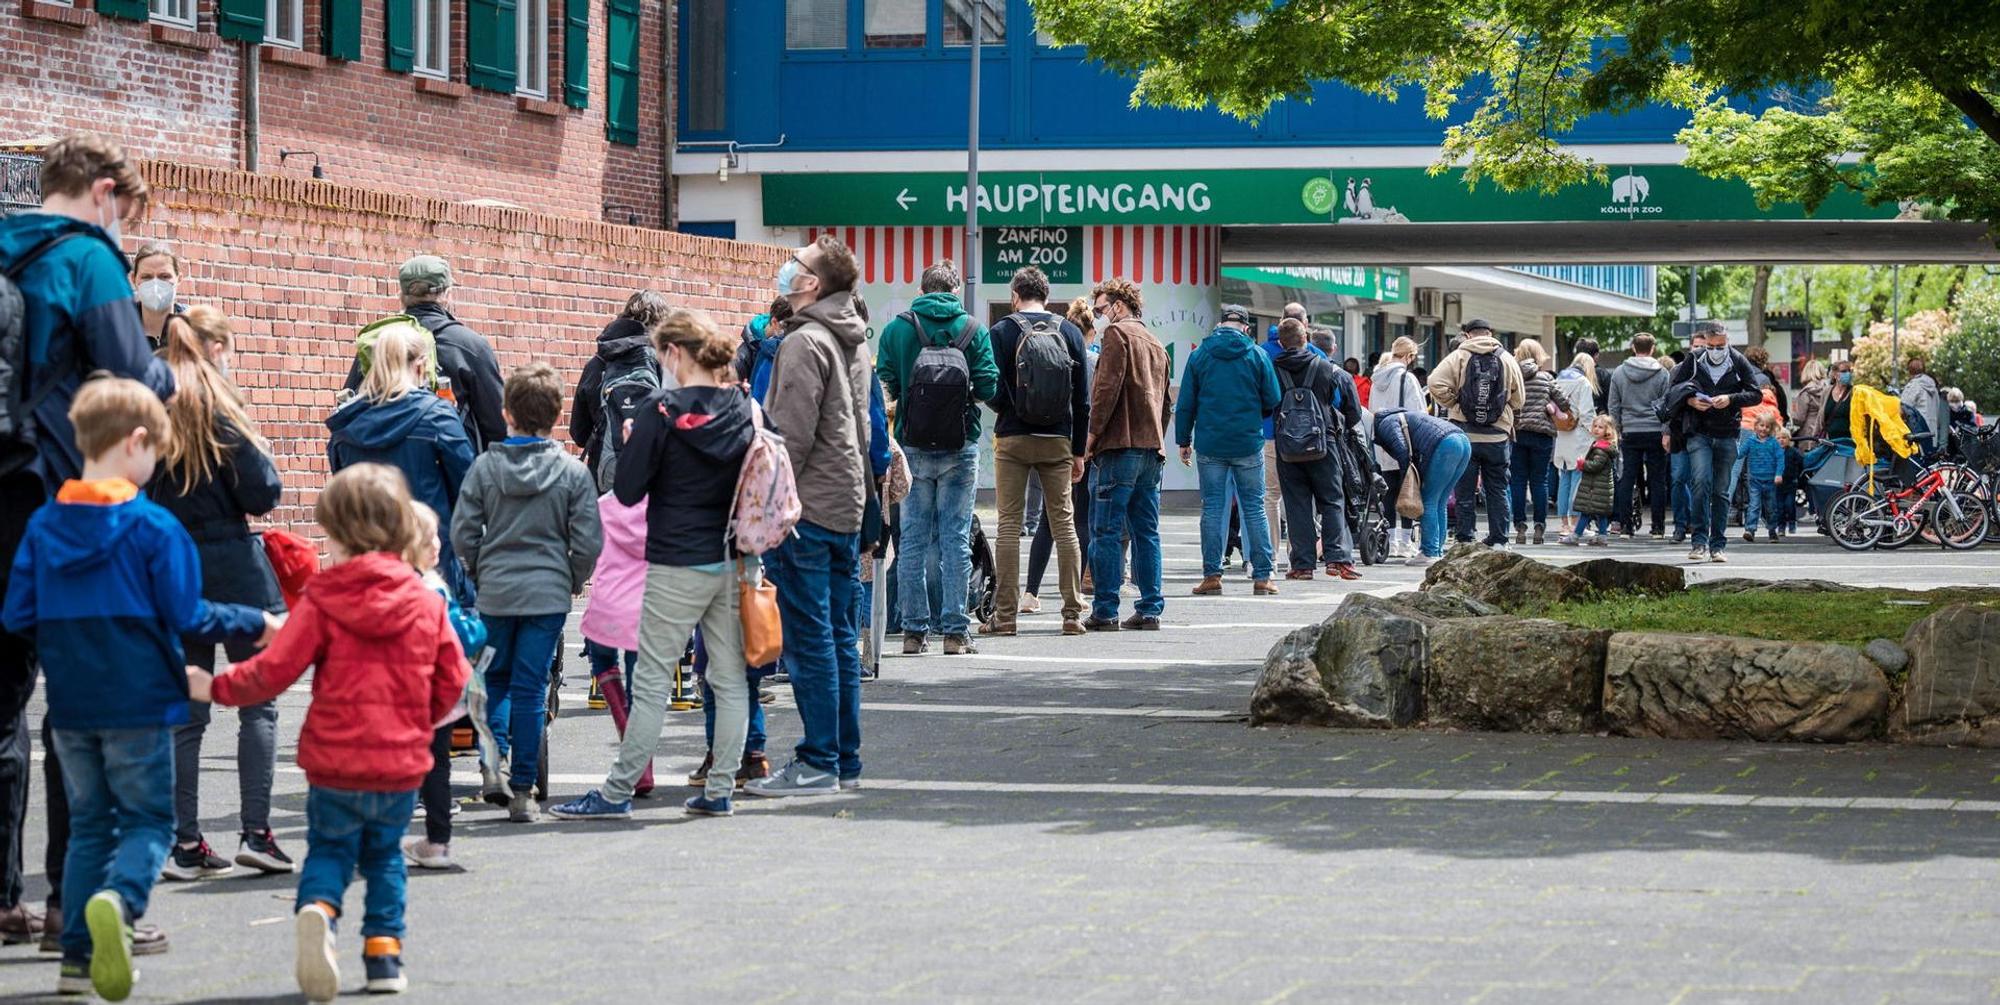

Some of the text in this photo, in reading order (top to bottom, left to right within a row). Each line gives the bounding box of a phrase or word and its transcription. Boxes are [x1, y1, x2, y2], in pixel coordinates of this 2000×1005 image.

[946, 183, 1211, 213] HAUPTEINGANG
[997, 228, 1068, 245] ZANFINO
[997, 246, 1068, 265] AM ZOO
